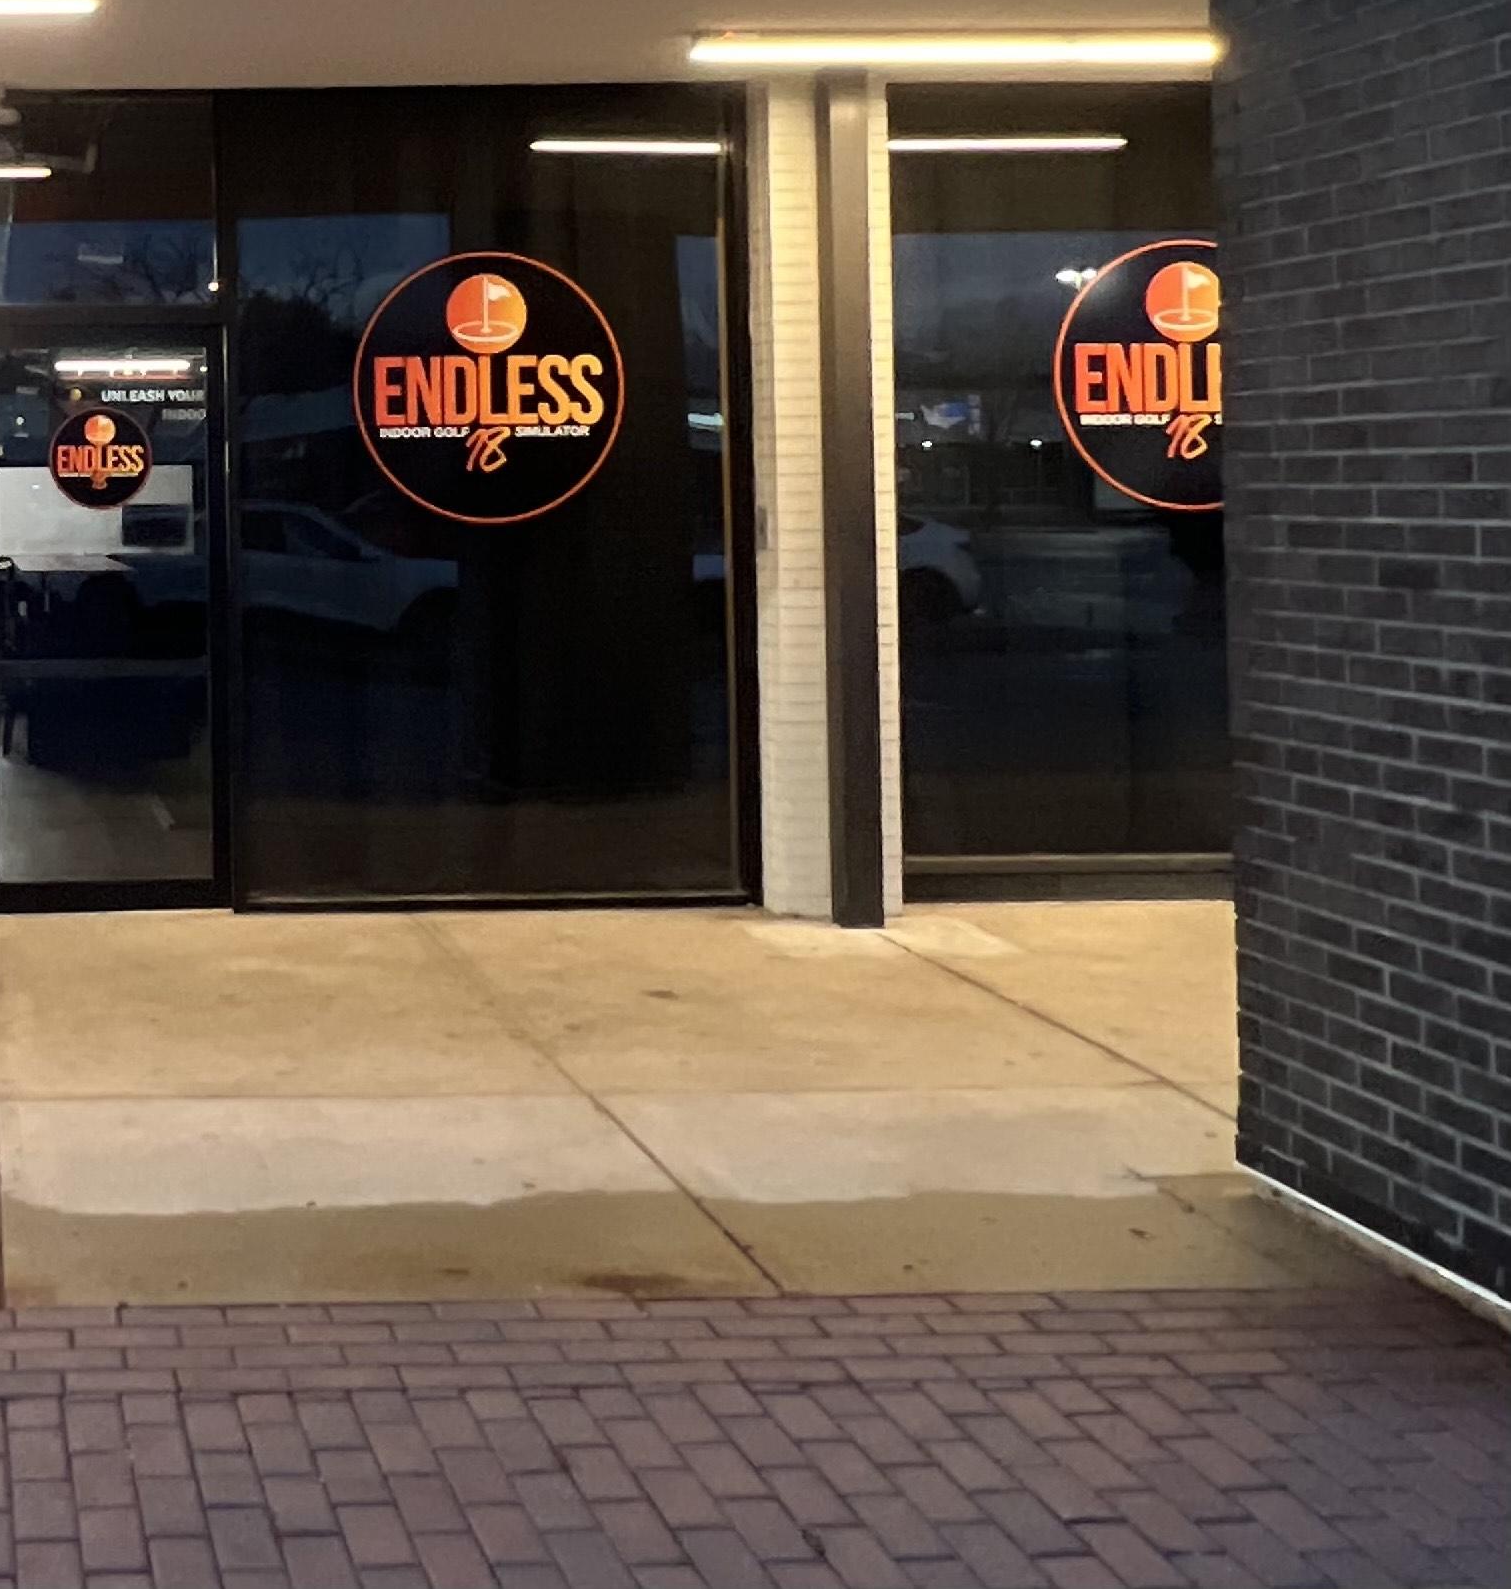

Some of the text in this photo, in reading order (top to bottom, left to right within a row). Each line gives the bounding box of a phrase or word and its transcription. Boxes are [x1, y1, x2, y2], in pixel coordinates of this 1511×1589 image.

[101, 389, 165, 402] UNLEASH
[374, 354, 604, 425] ENDLESS
[379, 426, 591, 438] INDOOR GOLF SIMULATOR
[466, 426, 512, 473] 18
[1166, 414, 1212, 459] 18
[57, 445, 145, 473] ENDLESS
